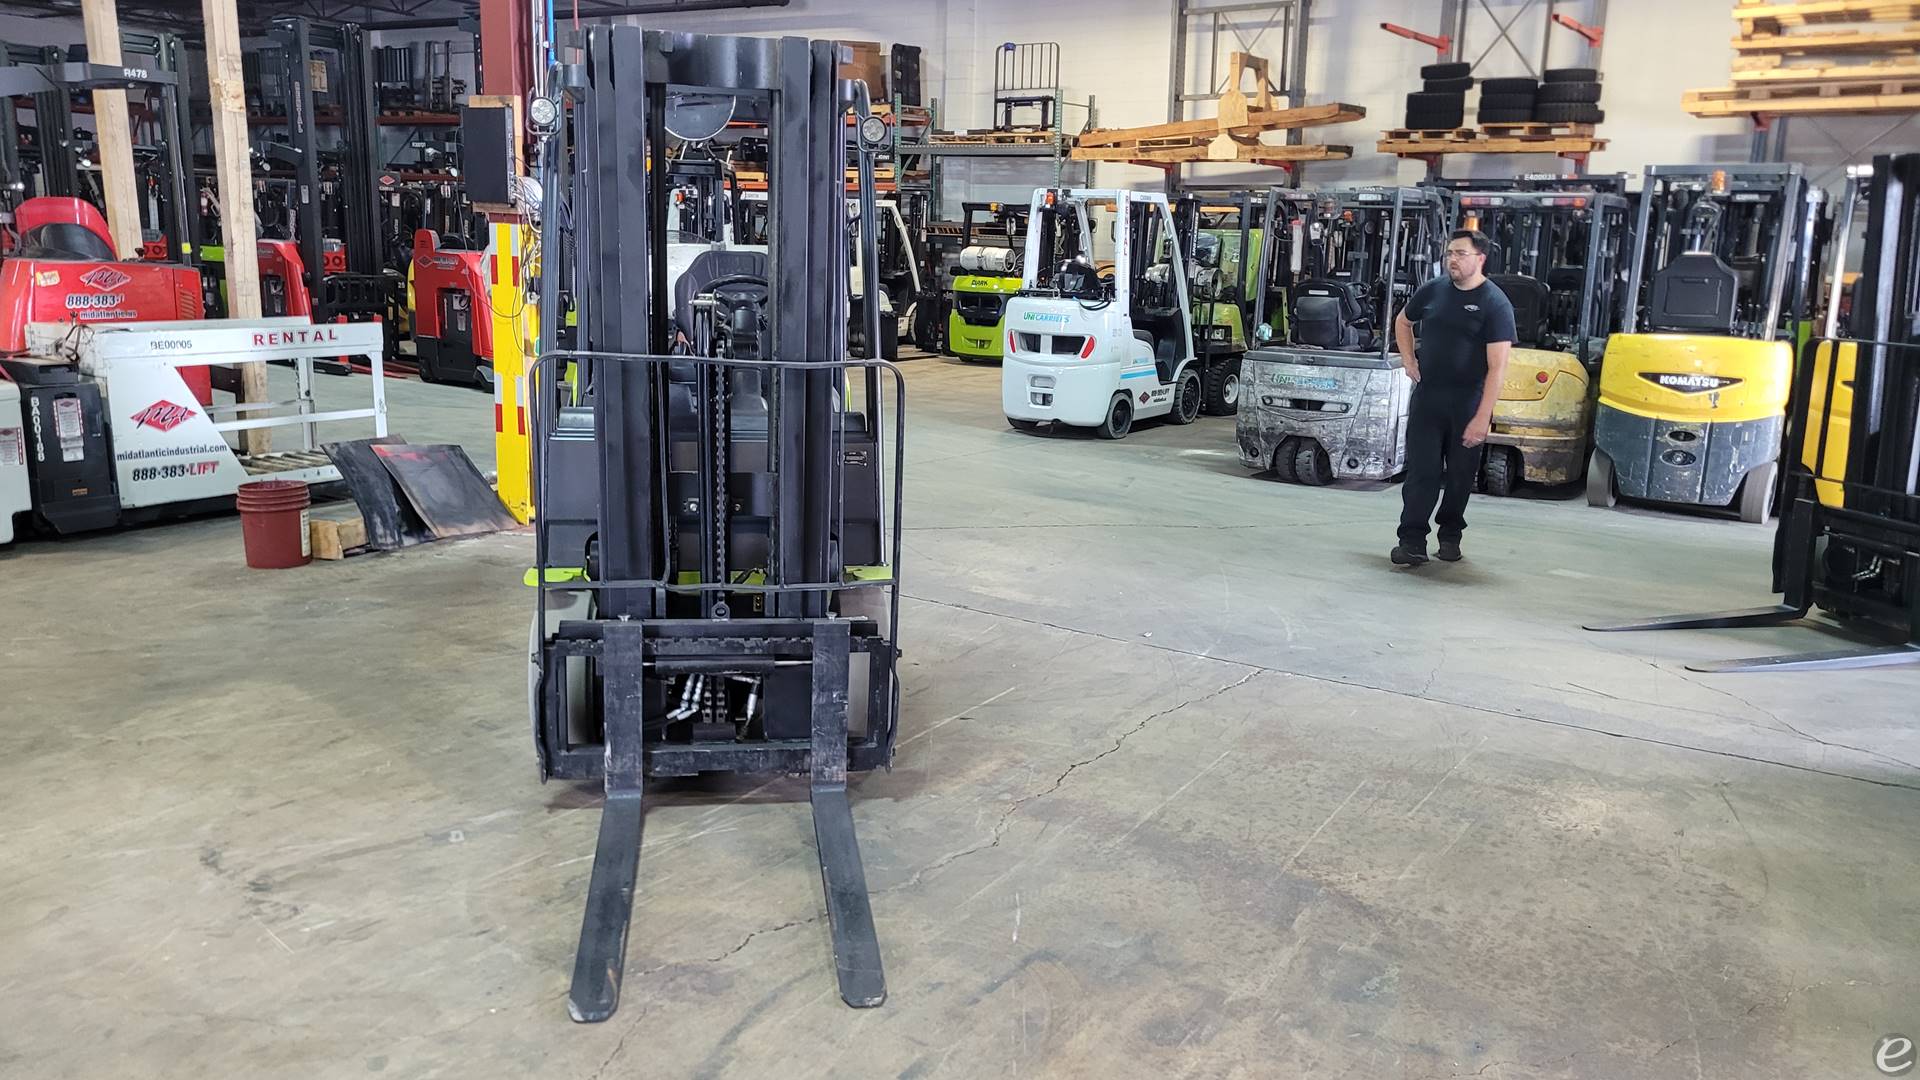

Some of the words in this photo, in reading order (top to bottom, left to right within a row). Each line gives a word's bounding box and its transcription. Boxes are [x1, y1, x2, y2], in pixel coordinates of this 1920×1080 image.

[123, 68, 148, 79] R478
[252, 328, 338, 346] RENTAL
[1660, 375, 1719, 388] KOMATSU
[117, 443, 228, 461] midatlanticindustrial.com
